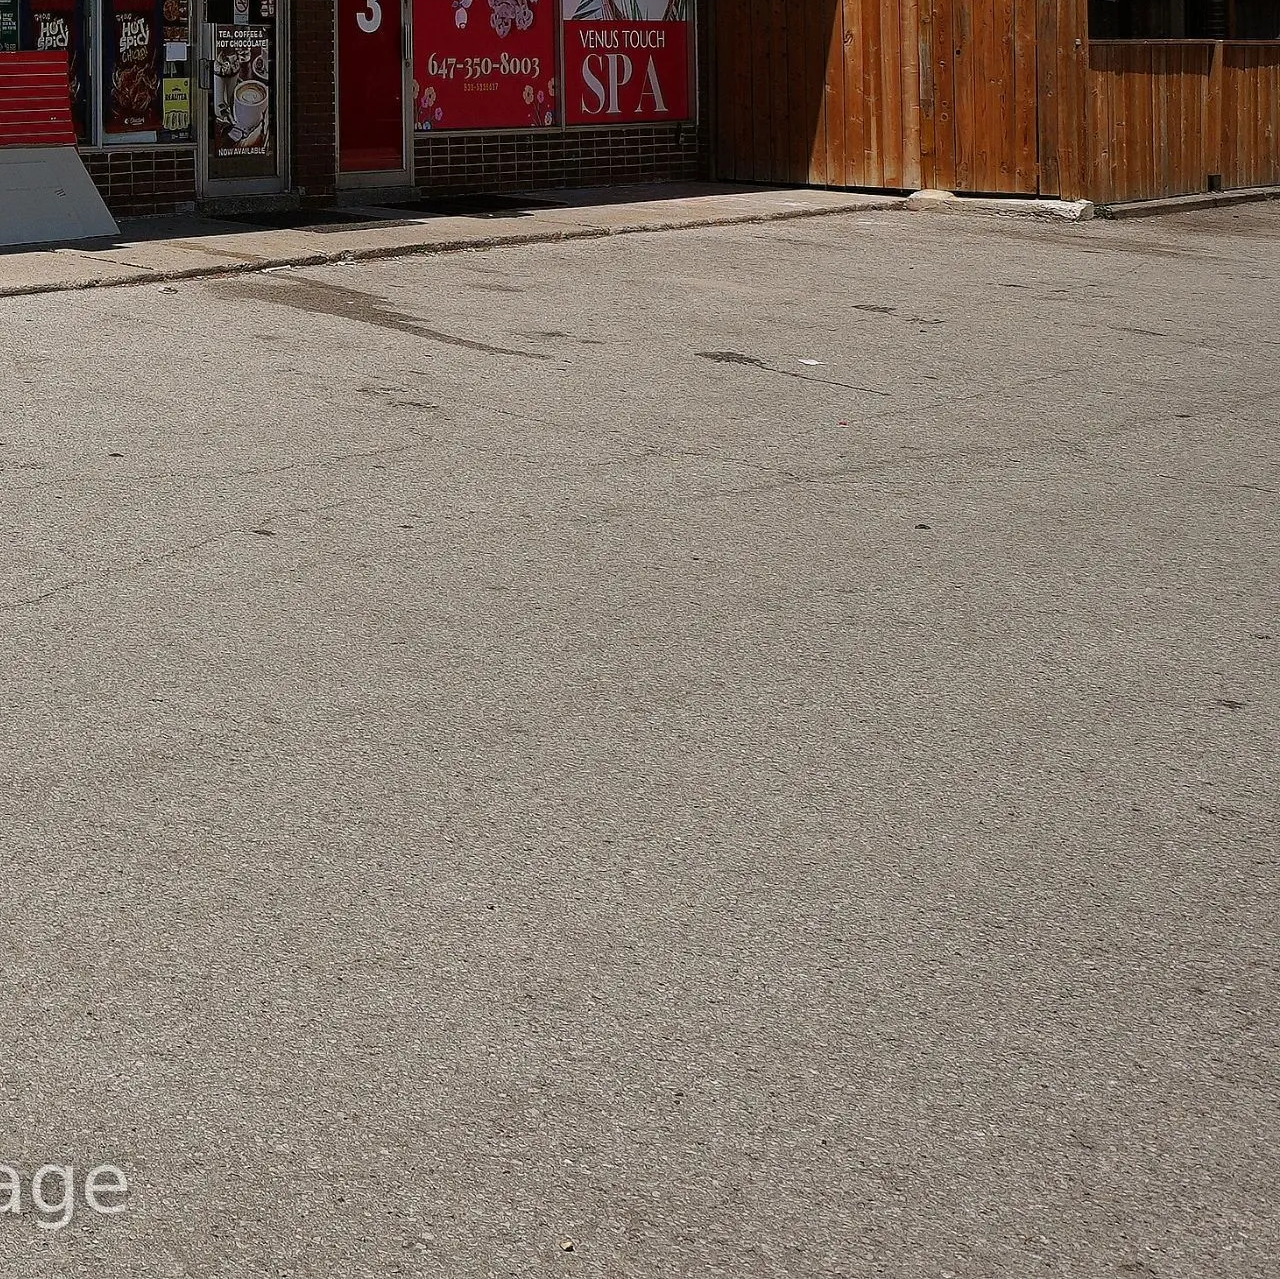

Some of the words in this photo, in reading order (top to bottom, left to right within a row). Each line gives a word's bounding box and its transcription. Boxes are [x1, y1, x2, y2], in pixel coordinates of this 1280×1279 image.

[41, 18, 64, 36] HOT
[122, 18, 145, 37] HOT
[216, 40, 228, 48] HOT
[579, 29, 619, 49] VENUS
[622, 30, 665, 49] TOUCH
[428, 52, 540, 80] 647-350-8003
[581, 53, 669, 114] SPA
[219, 147, 233, 156] NOW
[233, 146, 266, 156] AVAILABLE
